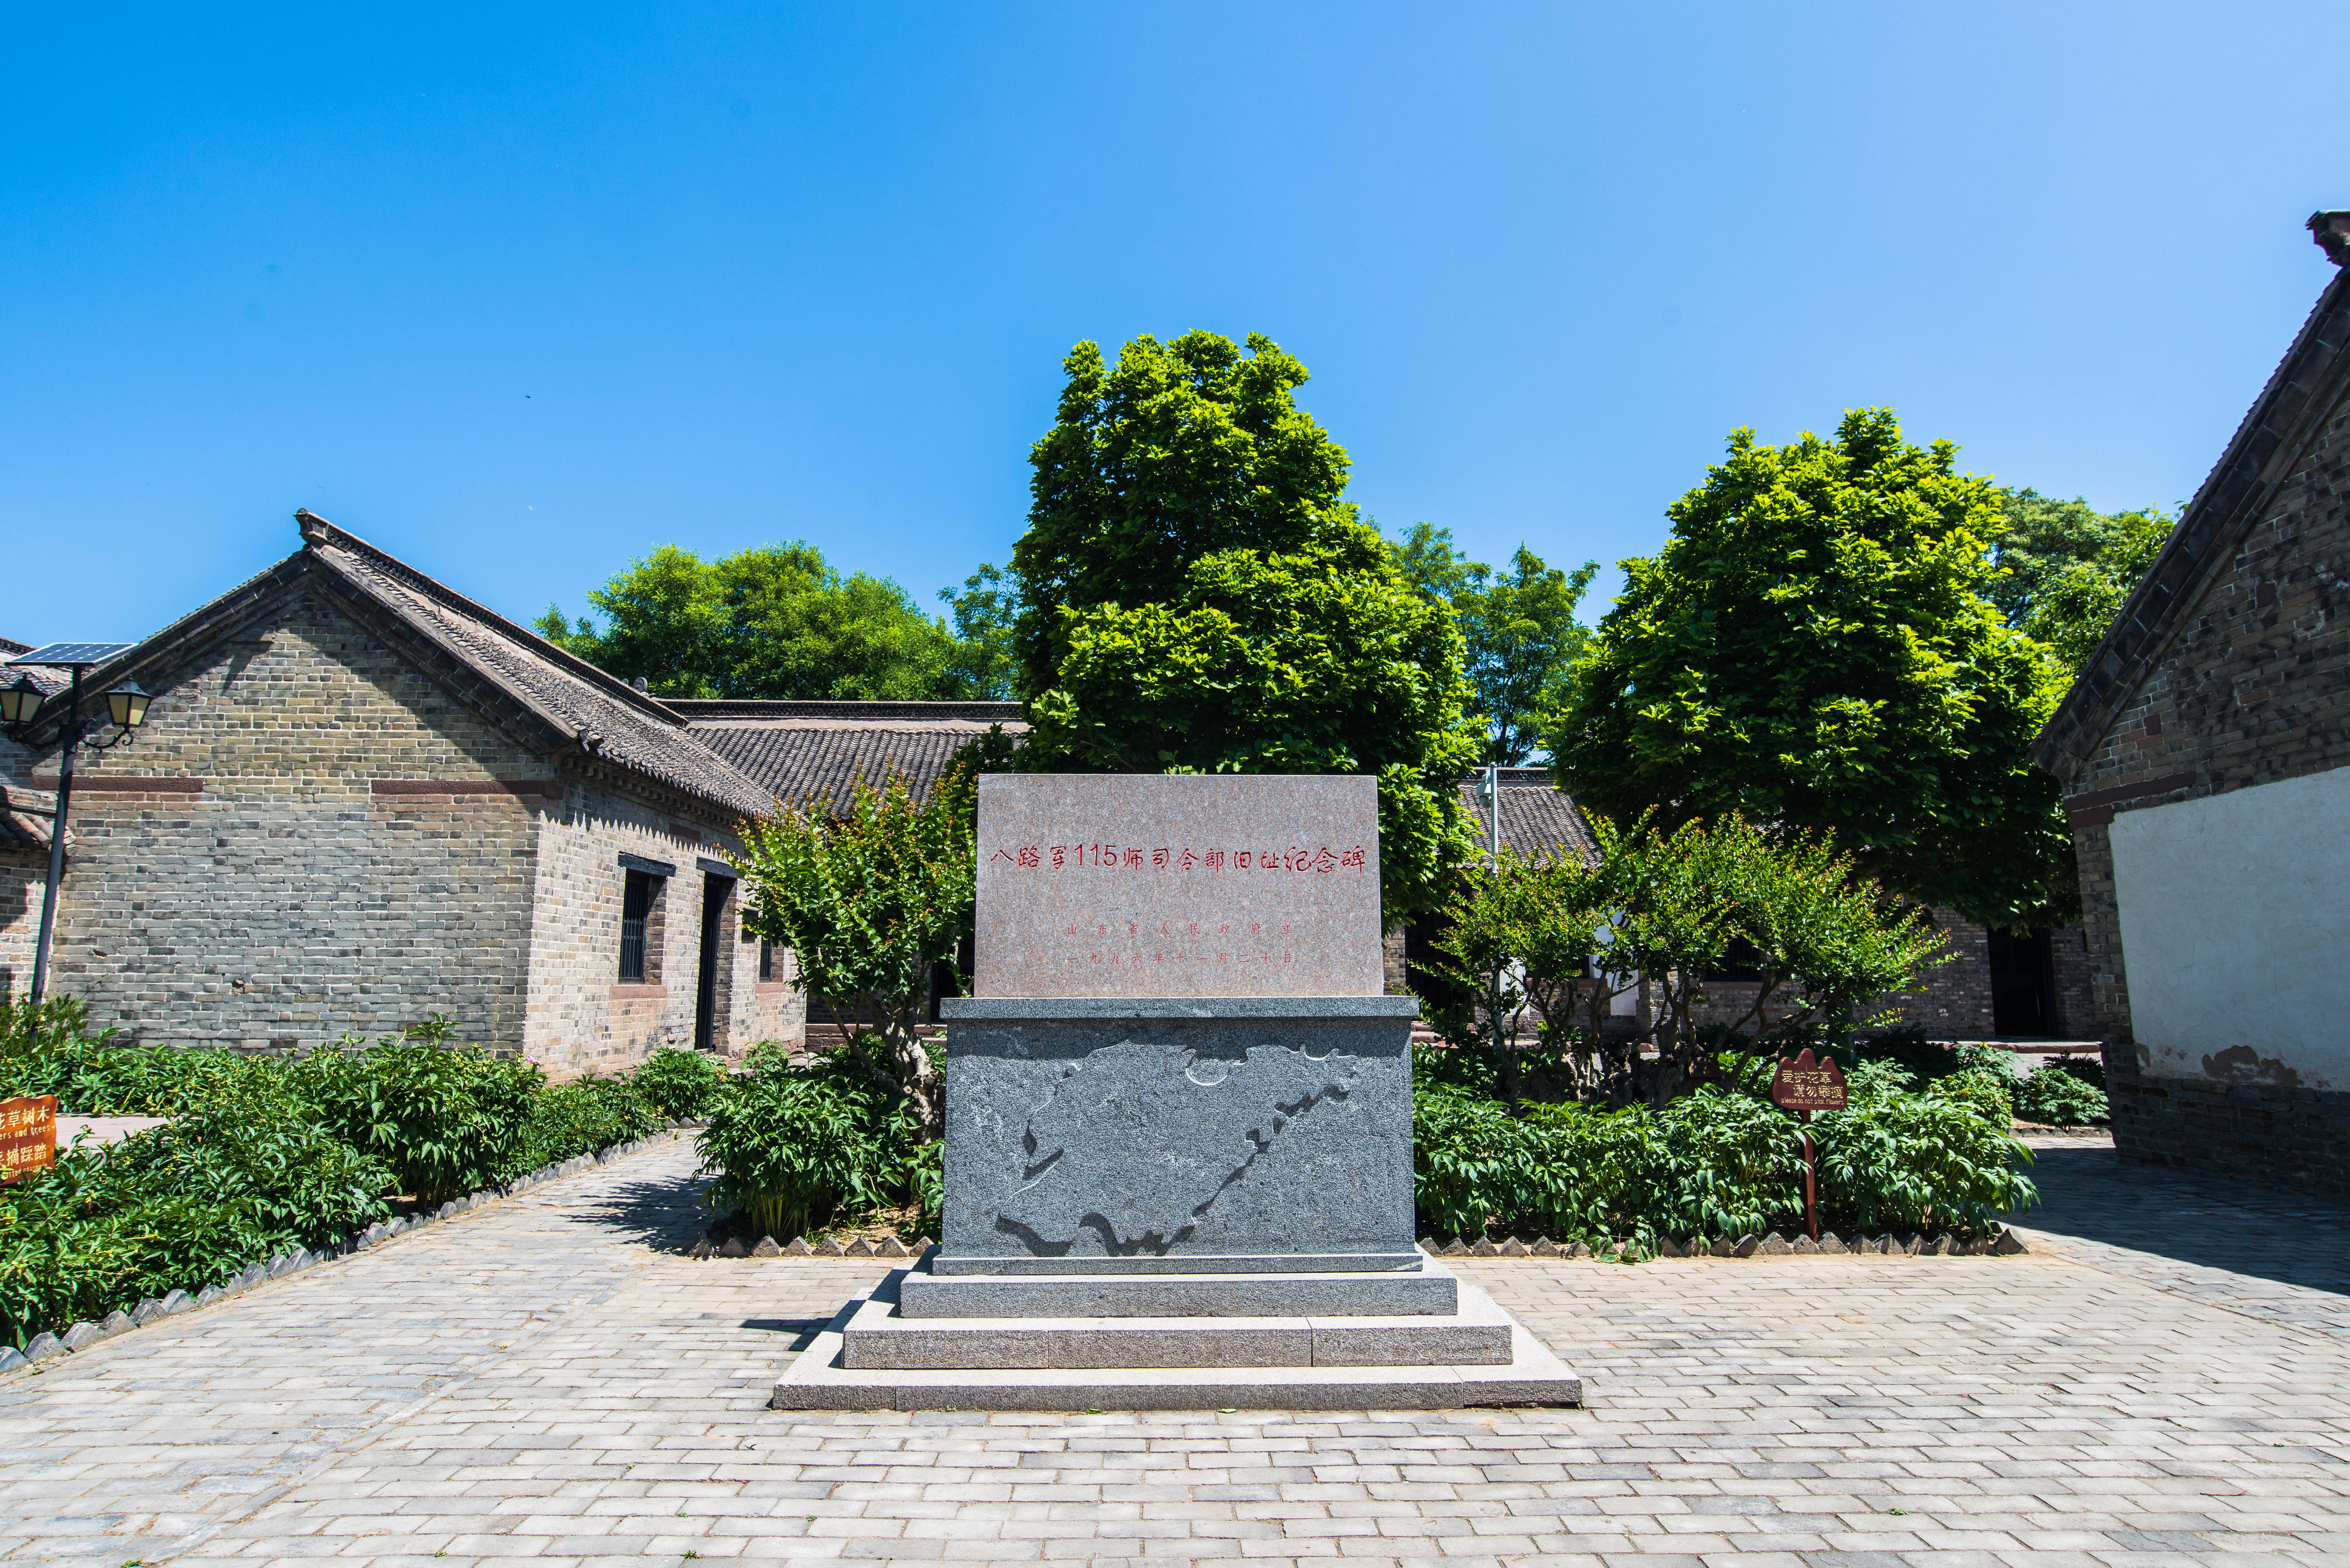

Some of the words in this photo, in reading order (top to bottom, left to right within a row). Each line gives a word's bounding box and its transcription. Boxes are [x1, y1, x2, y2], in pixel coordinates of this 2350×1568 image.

[989, 843, 1366, 875] 八路军115师司令部旧址纪念碑
[1067, 922, 1292, 935] 山东省人民政府立
[1067, 952, 1291, 965] 一九九六年十一月二十日
[1781, 1070, 1832, 1084] 爱护花草
[1793, 1084, 1843, 1098] 请勿攀摘
[14, 1127, 27, 1137] and
